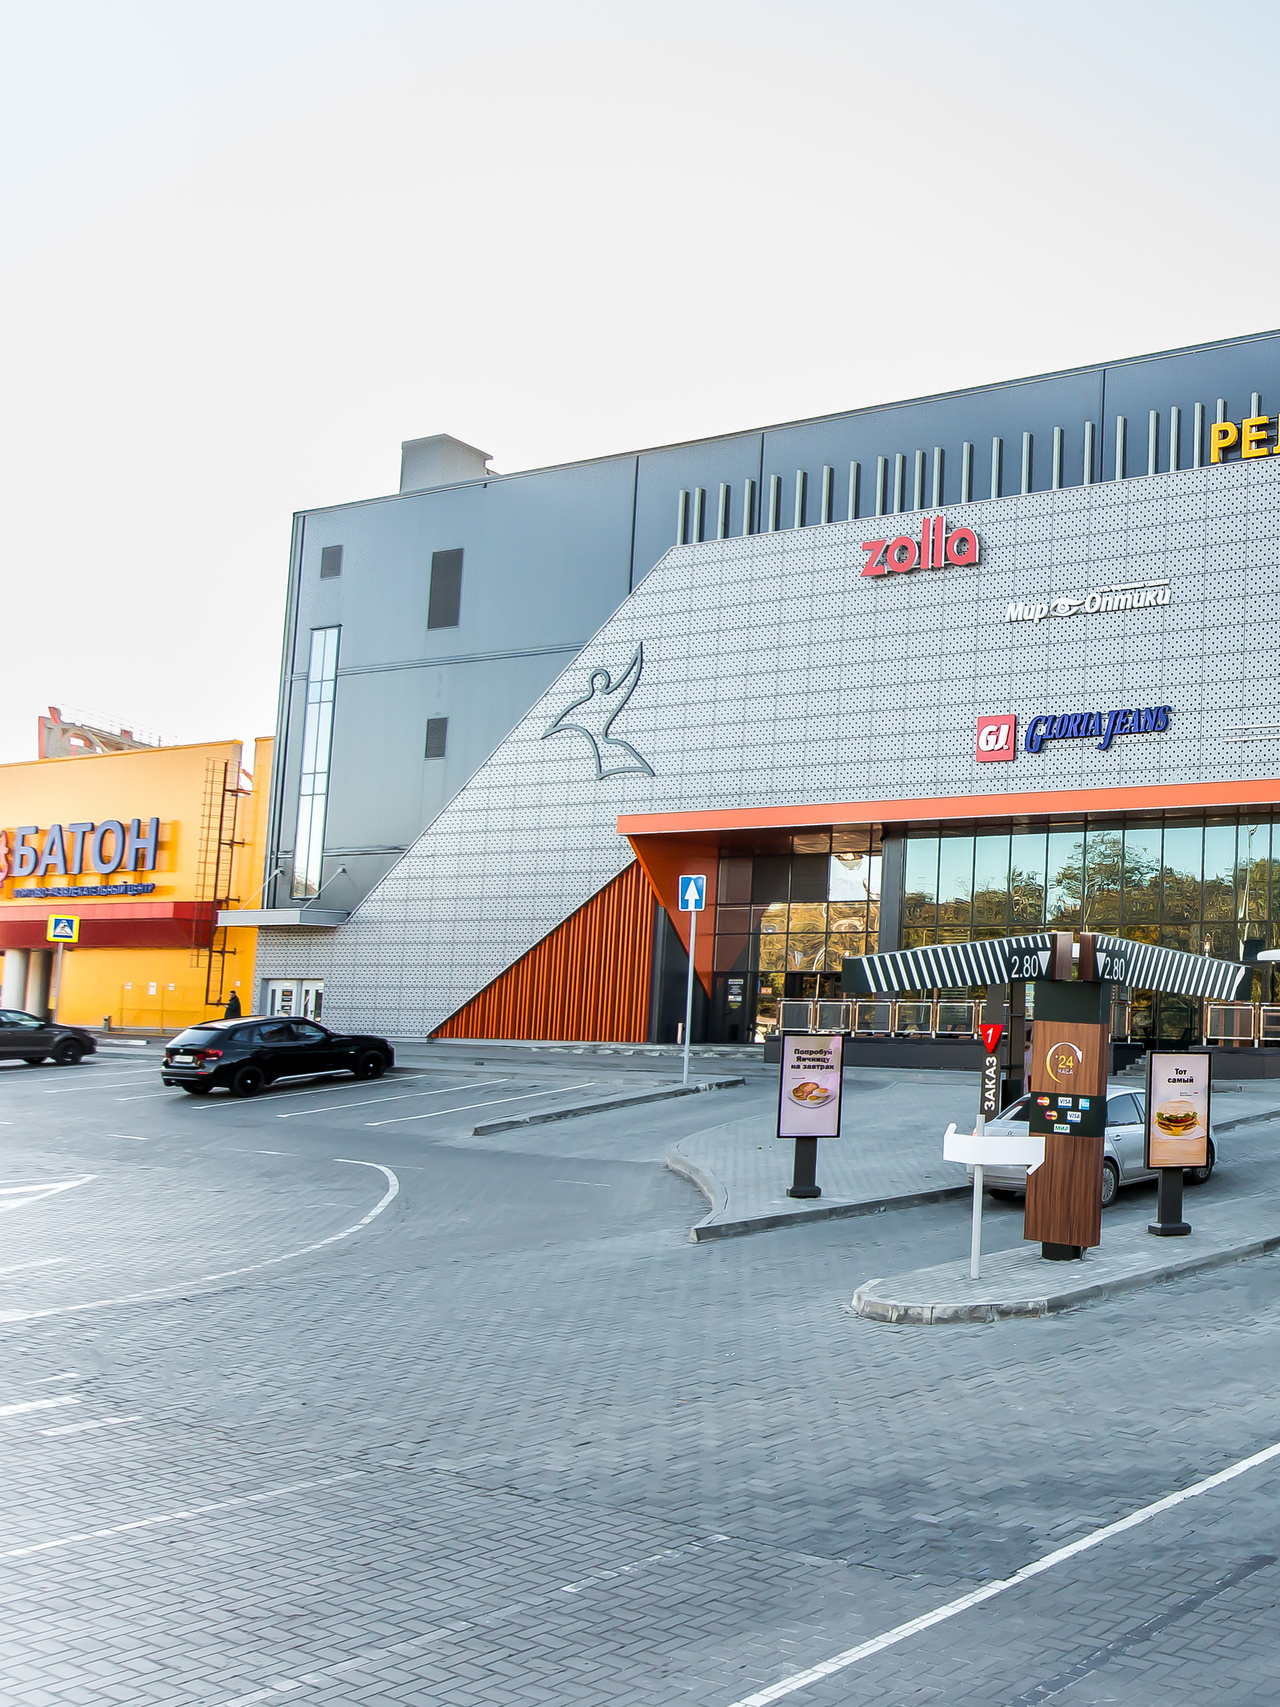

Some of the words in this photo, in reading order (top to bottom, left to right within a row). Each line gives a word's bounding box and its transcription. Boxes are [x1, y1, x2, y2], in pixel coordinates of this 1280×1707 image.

[860, 515, 979, 578] zolla
[1004, 601, 1049, 624] Мир
[1084, 587, 1172, 615] Оптики
[1024, 711, 1102, 753] GLORIA
[1096, 704, 1172, 751] JEANS
[13, 817, 160, 877] БАТОН
[1011, 954, 1039, 979] 2.80
[1104, 956, 1126, 981] 2.80
[986, 1027, 994, 1043] 1
[794, 1048, 833, 1056] Попробуй
[1058, 1054, 1074, 1069] 24
[984, 1056, 997, 1111] ЗАКАЗ
[1167, 1075, 1194, 1084] самый
[1174, 1067, 1187, 1076] Тот
